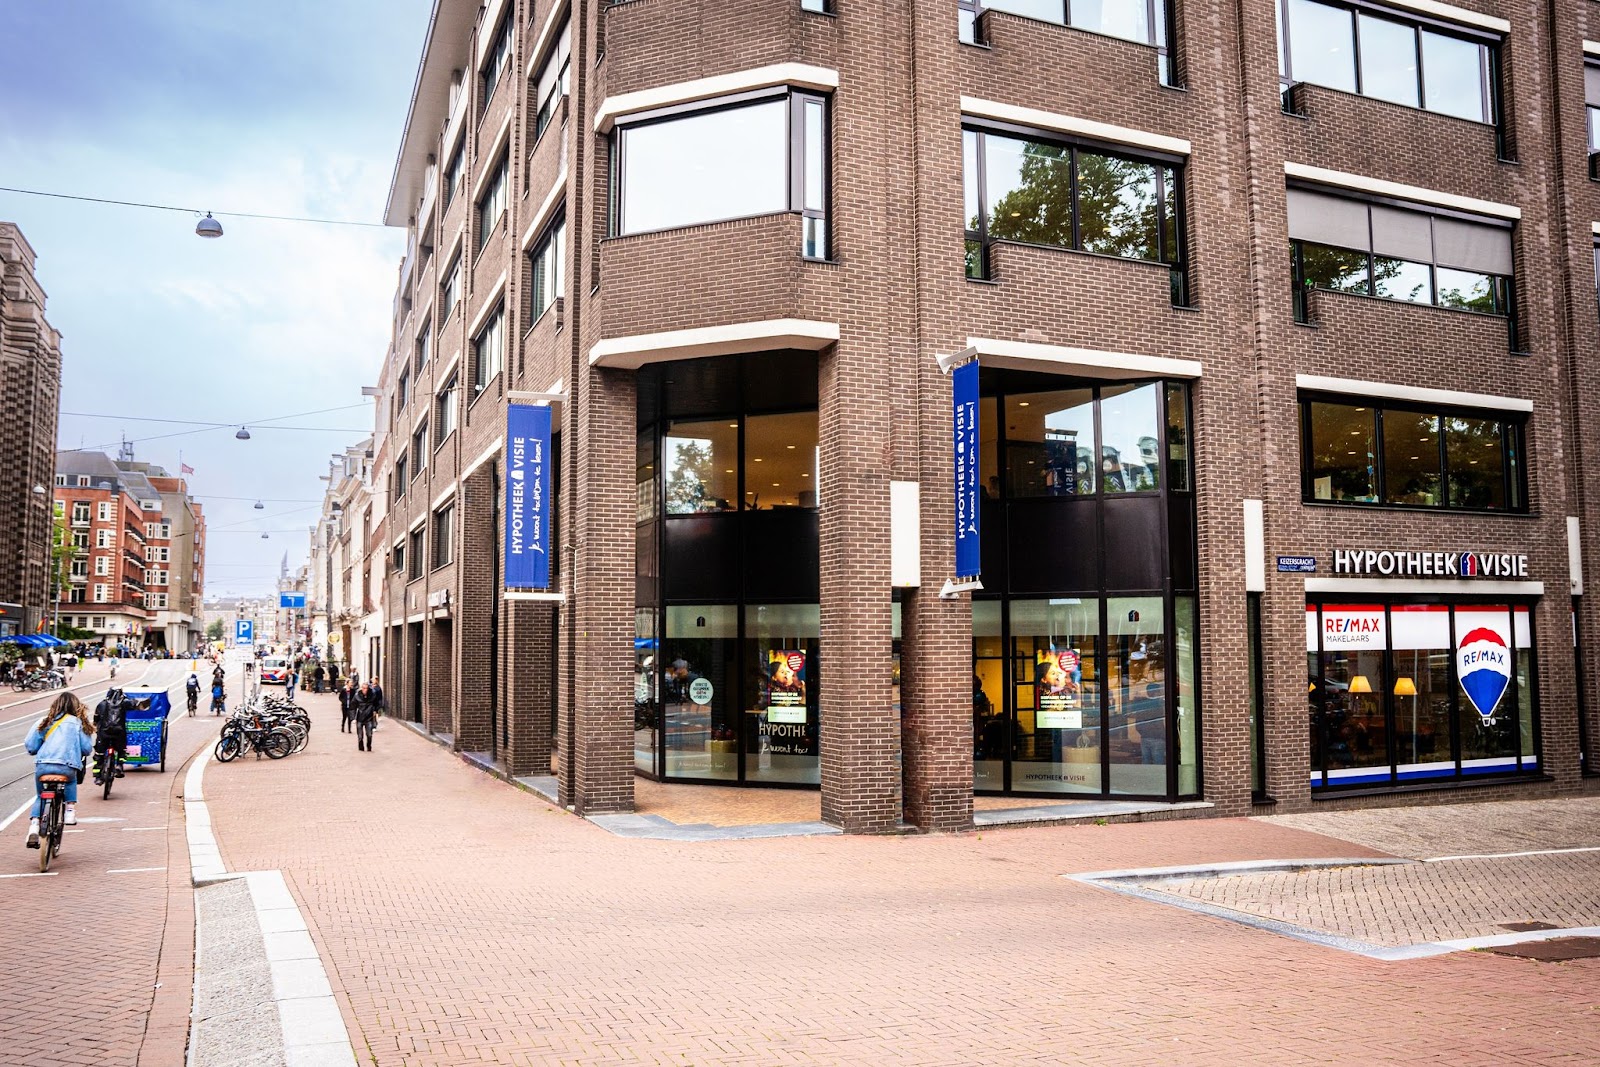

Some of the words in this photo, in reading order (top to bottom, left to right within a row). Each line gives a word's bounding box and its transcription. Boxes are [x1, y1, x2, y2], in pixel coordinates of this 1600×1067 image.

[956, 404, 964, 440] VISIE
[513, 437, 524, 467] VISIE
[957, 456, 965, 539] HYPOTHEEK
[512, 482, 524, 554] HYPOTHEEK
[1335, 551, 1457, 575] HYPOTHEEK
[1480, 554, 1529, 577] VISIE
[238, 622, 250, 636] P
[1326, 618, 1380, 633] RE/MAX
[1326, 635, 1370, 643] MAKELAARS
[1463, 650, 1504, 667] RE/MAX
